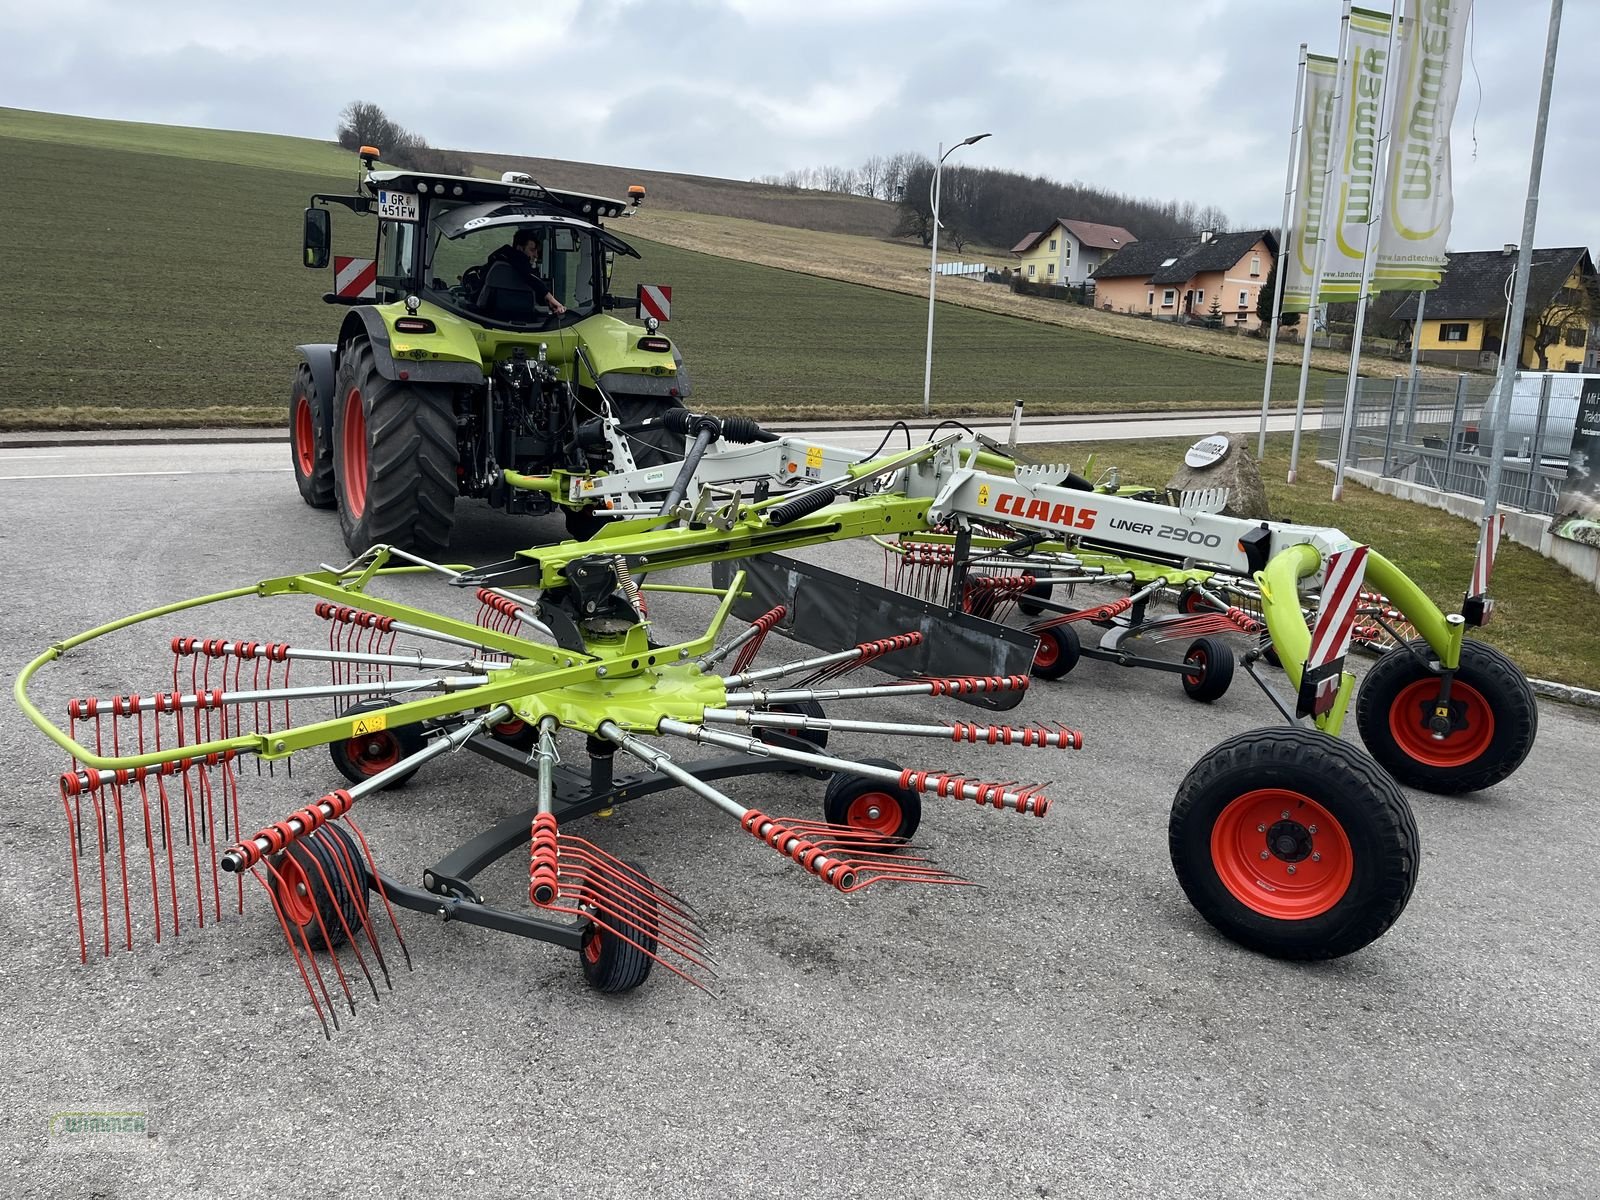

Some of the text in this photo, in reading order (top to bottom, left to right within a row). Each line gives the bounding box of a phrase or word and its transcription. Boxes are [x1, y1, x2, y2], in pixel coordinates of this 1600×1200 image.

[1346, 47, 1386, 224] WIMMER
[391, 194, 404, 206] GR
[508, 187, 546, 199] CLAAS
[382, 204, 416, 218] 451FW
[994, 493, 1098, 530] CLAAS
[1109, 518, 1221, 548] LINER 2900
